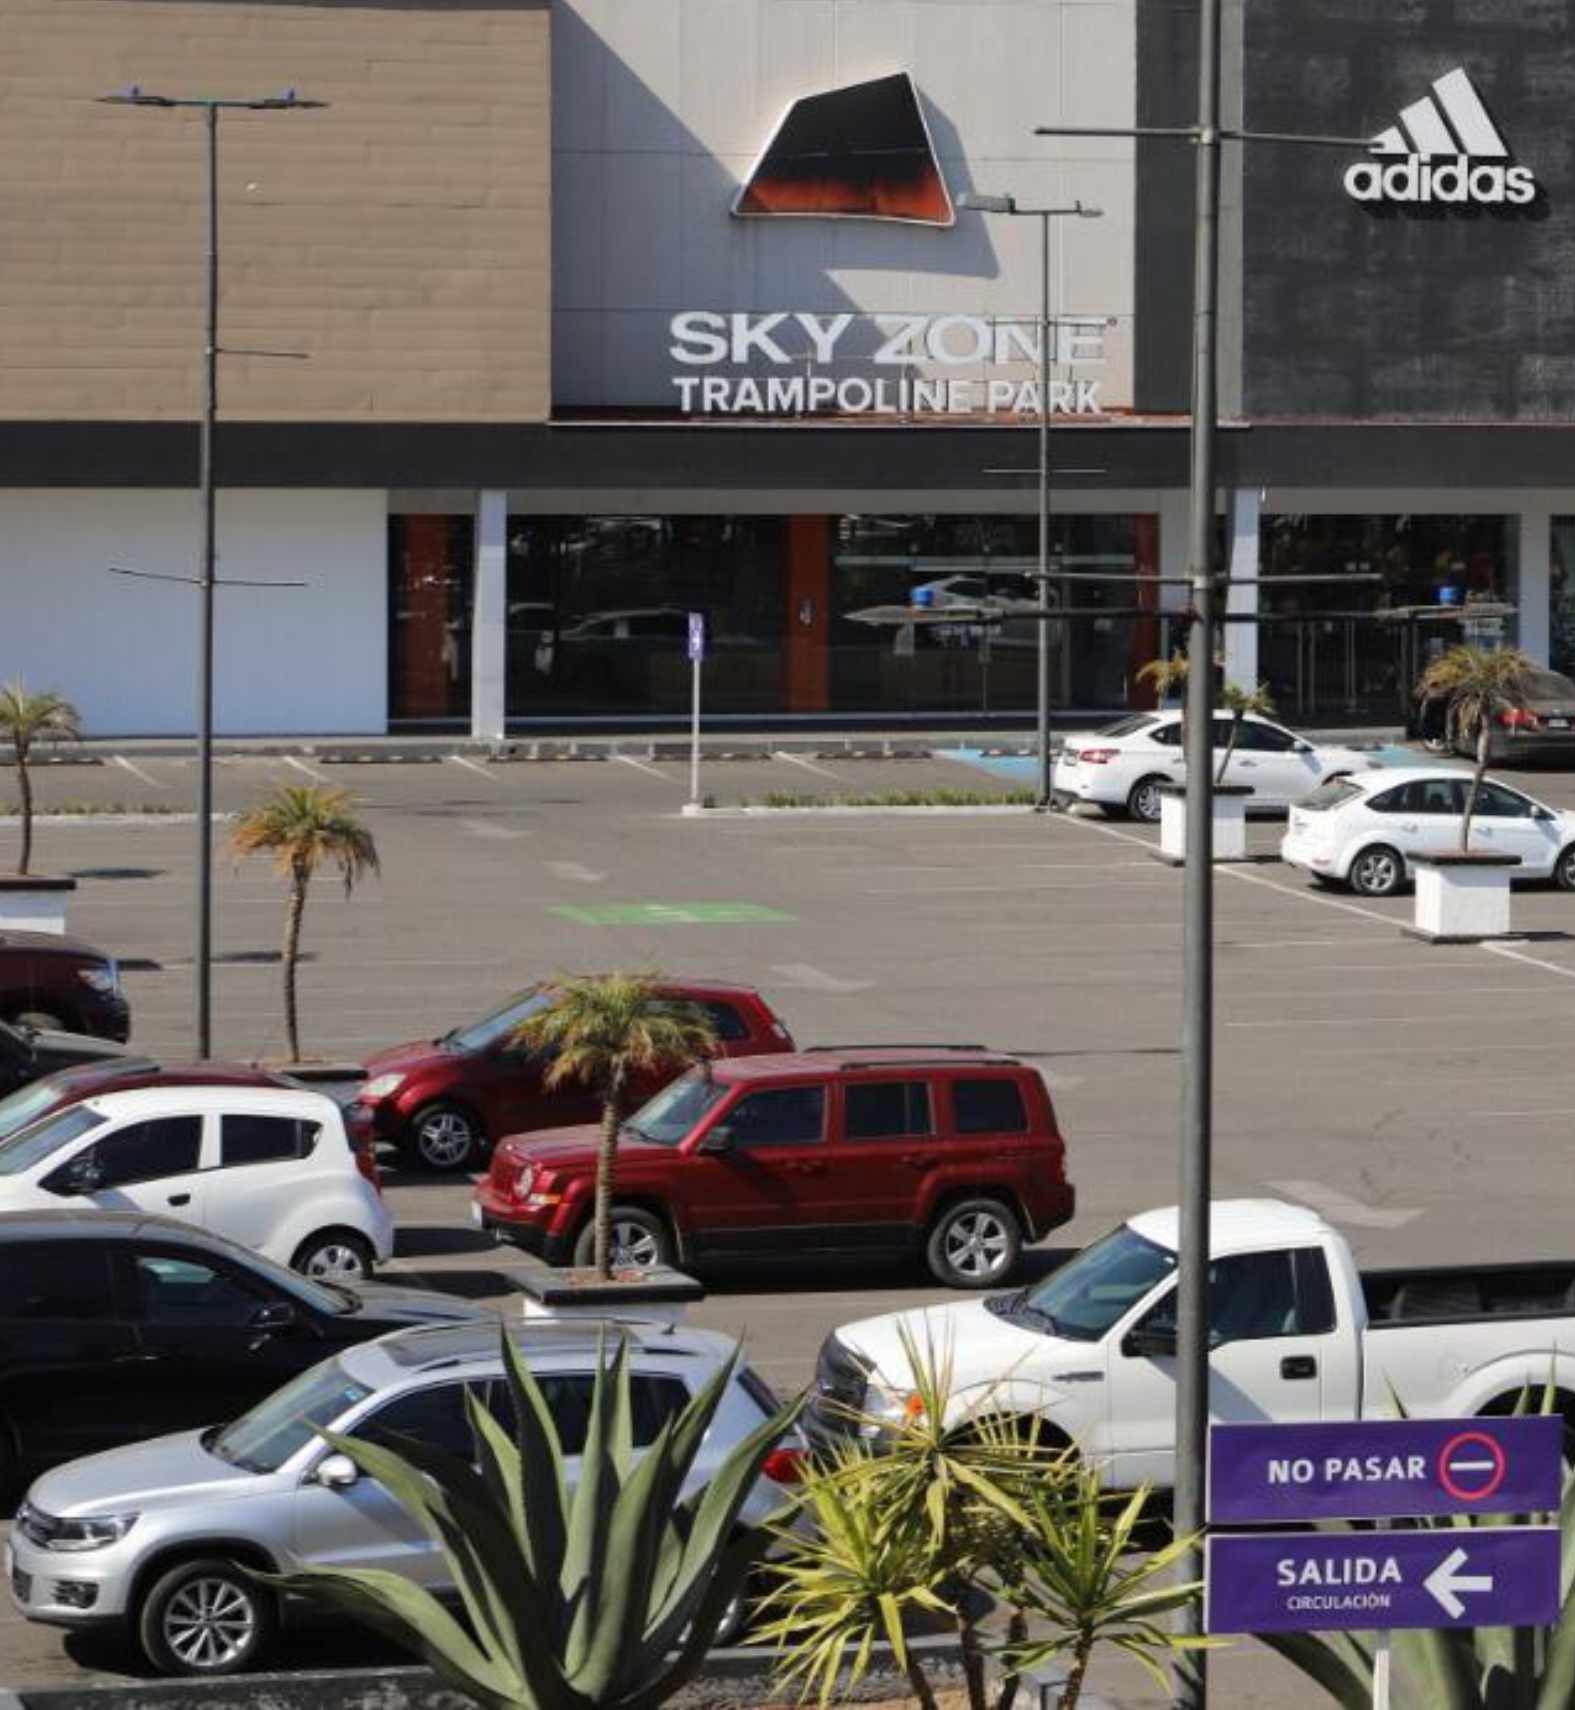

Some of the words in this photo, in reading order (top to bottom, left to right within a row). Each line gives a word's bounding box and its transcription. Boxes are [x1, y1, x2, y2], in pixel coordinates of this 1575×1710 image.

[1343, 152, 1536, 205] adidas
[669, 311, 855, 365] SKY
[873, 313, 1105, 366] ZONE
[671, 376, 974, 414] TRAMPOLINE
[987, 379, 1103, 414] PARK
[1267, 1459, 1315, 1484] NO
[1325, 1454, 1426, 1481] PASAR
[1277, 1557, 1403, 1587] SALIDA
